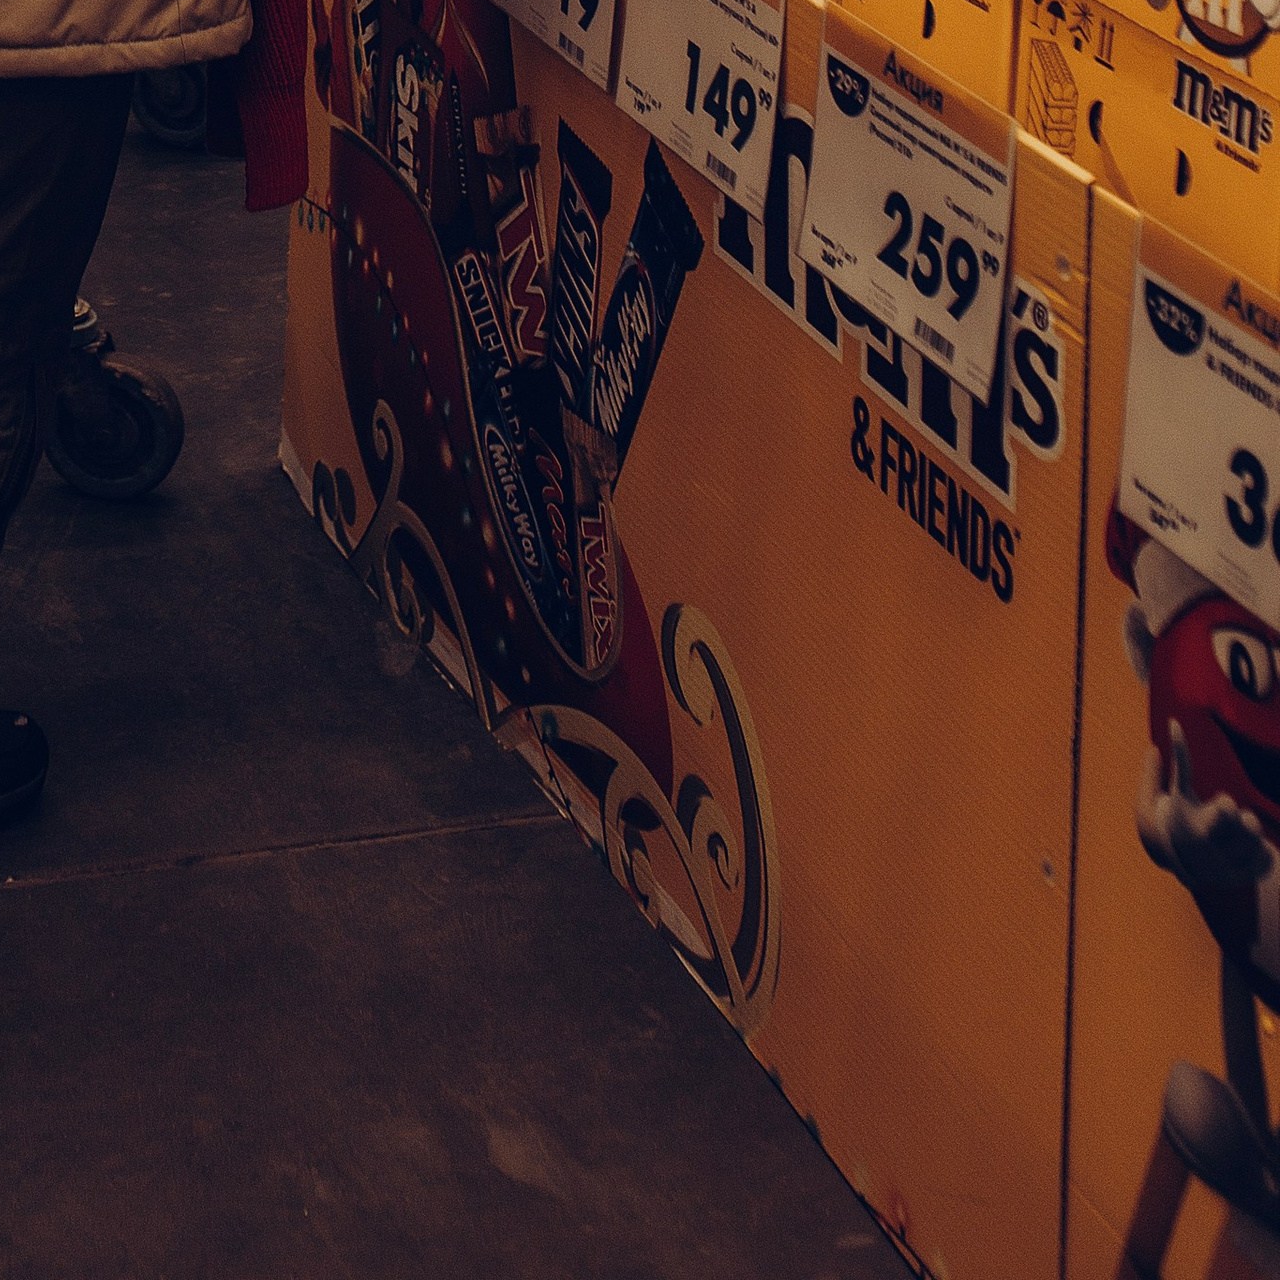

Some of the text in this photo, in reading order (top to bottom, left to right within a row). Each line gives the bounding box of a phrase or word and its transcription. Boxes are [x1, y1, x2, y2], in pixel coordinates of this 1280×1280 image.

[685, 39, 757, 153] 149
[758, 87, 772, 112] 99
[829, 67, 866, 105] -29%
[883, 49, 944, 115] Акция
[1174, 60, 1272, 154] m&m's
[876, 191, 980, 322] 259
[981, 248, 1000, 277] 99
[1148, 295, 1200, 344] -32%
[851, 396, 876, 483] &
[880, 416, 1015, 604] FRIENDS
